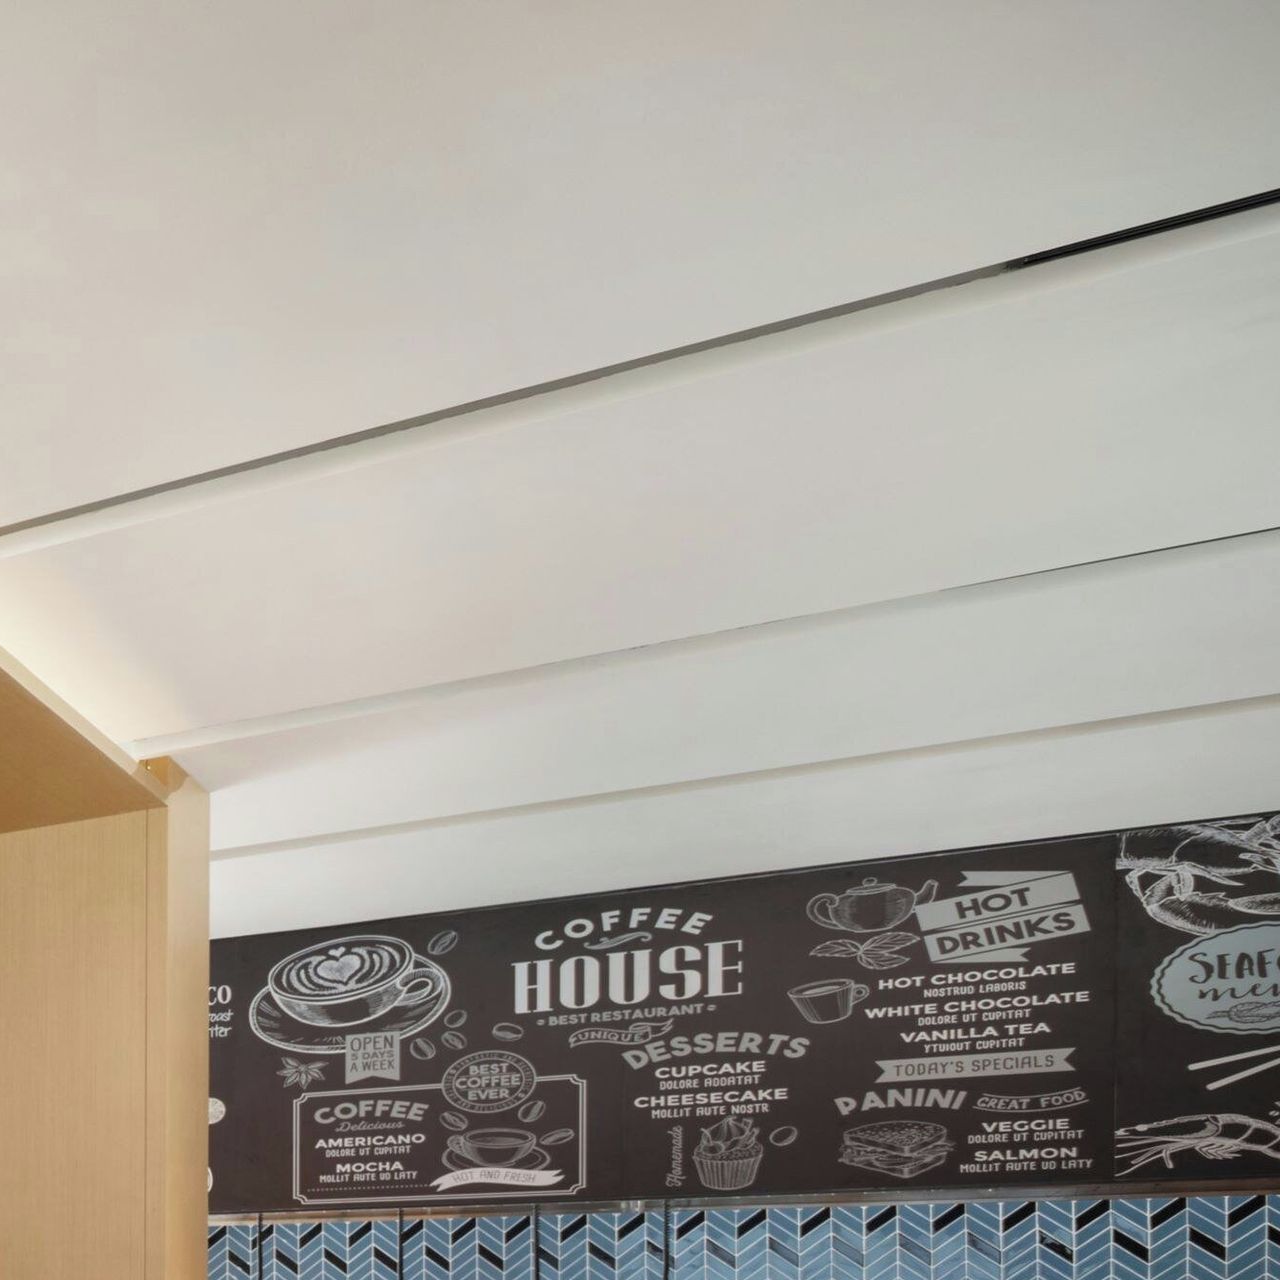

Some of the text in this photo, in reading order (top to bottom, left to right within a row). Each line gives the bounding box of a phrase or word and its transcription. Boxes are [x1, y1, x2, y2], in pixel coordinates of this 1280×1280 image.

[955, 887, 1030, 919] HOT
[535, 907, 713, 950] COFFEE
[937, 912, 1075, 955] DRINKS
[1188, 949, 1280, 984] SEAF
[511, 940, 742, 1014] HOUSE
[878, 963, 1076, 990] HOT CHOCOLATE
[923, 985, 974, 998] NOSTRUD
[864, 991, 1090, 1019] WHITE CHOCOLATE
[548, 1003, 704, 1026] BEST RESTAURANT
[918, 1009, 1031, 1026] DOLORE UT CUPITAT
[578, 1030, 643, 1042] UNIQUE
[900, 1022, 1052, 1043] VANILLA TEA
[350, 1034, 394, 1051] OPEN
[976, 1037, 1025, 1050] CUPITAT
[351, 1051, 394, 1061] 5 DAYS
[622, 1032, 810, 1070] DESSERTS
[350, 1059, 395, 1073] A WEEK
[469, 1063, 509, 1074] BEST
[654, 1060, 766, 1079] CUPCAKE
[894, 1054, 1054, 1077] TODAY'S SPECIALS
[455, 1074, 521, 1089] COFFEE
[659, 1078, 700, 1090] DOLORE
[468, 1088, 509, 1100] EVER
[634, 1088, 788, 1108] CHEESECAKE
[835, 1088, 968, 1116] PANINI
[976, 1090, 1087, 1110] GREAT FOOD
[314, 1100, 430, 1124] COFFEE
[651, 1107, 692, 1119] MOLLIT
[731, 1103, 769, 1115] NOSTR
[335, 1120, 405, 1132] Delicious
[981, 1118, 1070, 1133] VEGGIE
[315, 1133, 426, 1149] AMERICANO
[968, 1129, 1085, 1144] DOLORE UT CUPITAT
[325, 1145, 411, 1158] DOLORE UT CUPITAT
[666, 1125, 686, 1187] Homemade
[974, 1147, 1078, 1162] SALMON
[336, 1161, 403, 1173] MOCHA
[960, 1163, 1000, 1173] MOLLIT
[319, 1174, 350, 1183] MOLLIT
[452, 1170, 536, 1183] HOT AND FRESH
